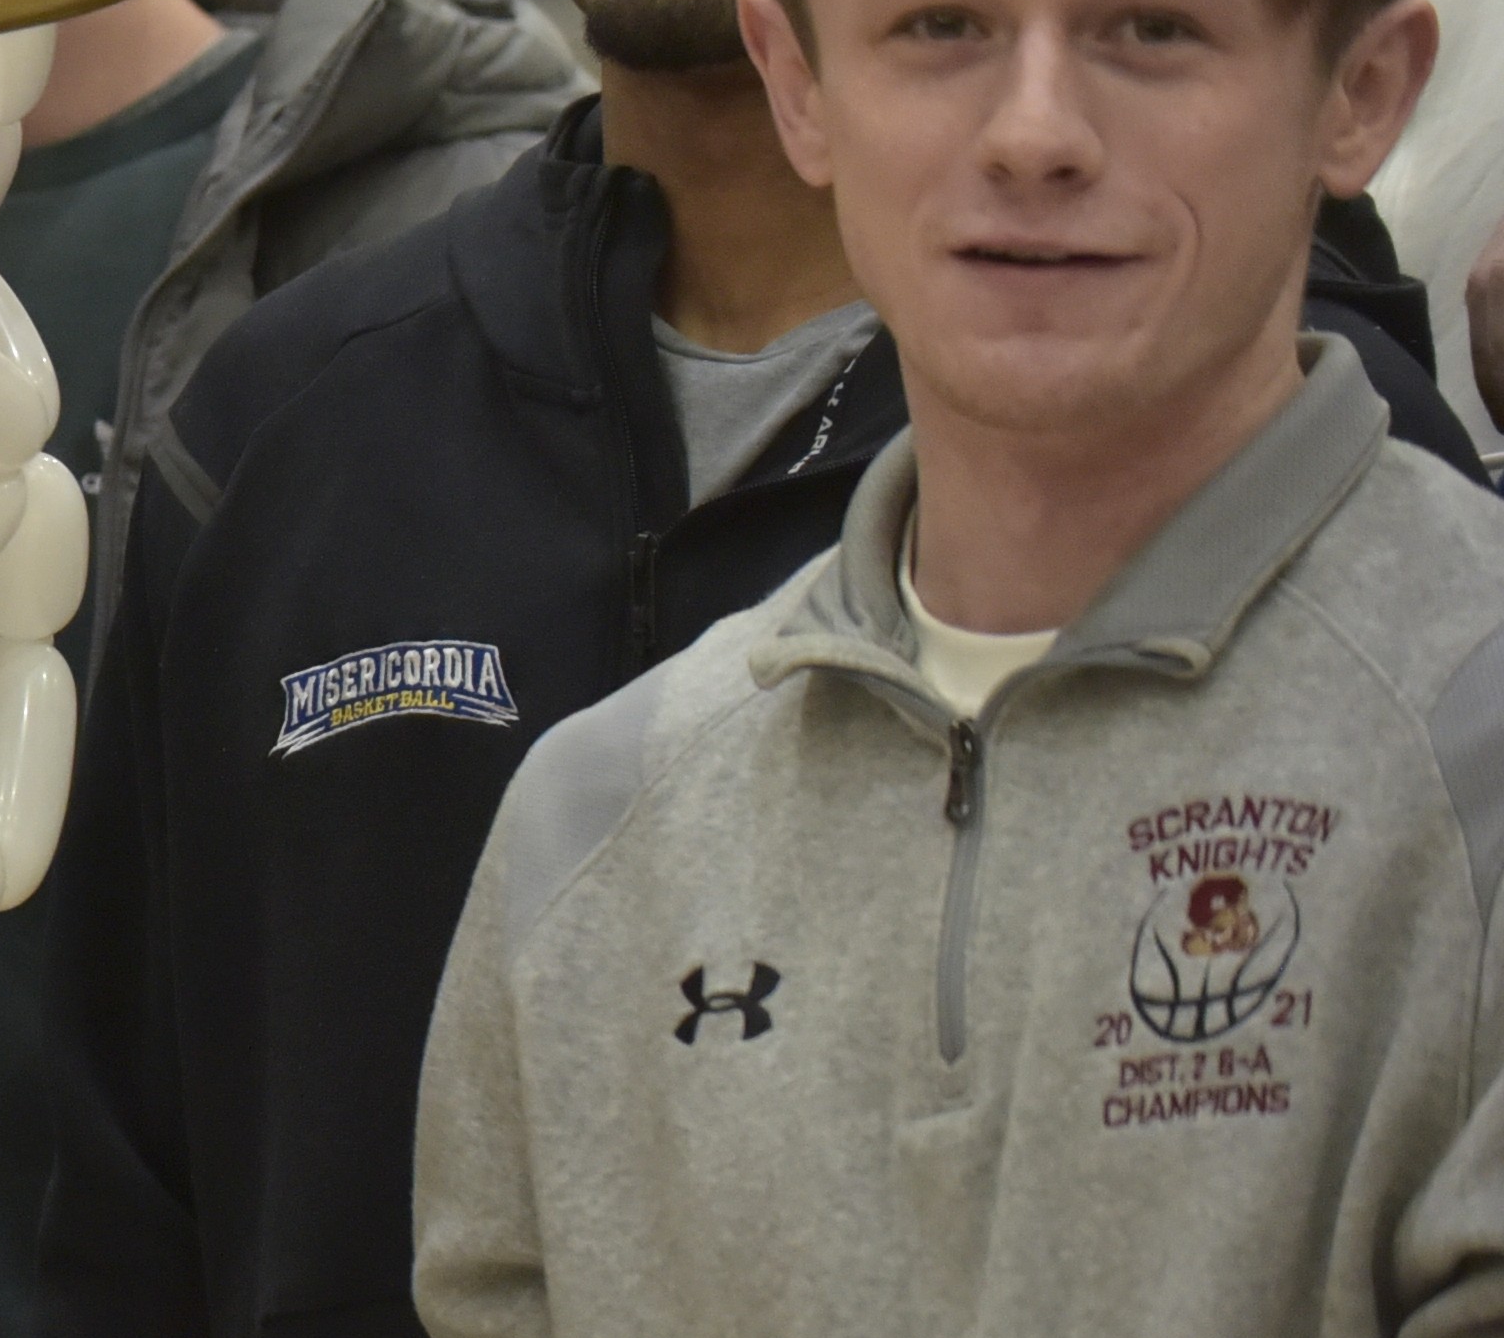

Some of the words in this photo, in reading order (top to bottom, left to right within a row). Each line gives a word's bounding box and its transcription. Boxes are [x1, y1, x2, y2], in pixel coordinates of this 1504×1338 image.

[289, 647, 504, 727] MISERICORDIA
[329, 689, 455, 728] BASKETBALL
[1126, 793, 1342, 853] SCRANTON
[1149, 836, 1315, 886] KNIGHTS
[1093, 1011, 1133, 1048] 20
[1270, 988, 1313, 1029] 21
[1102, 1081, 1291, 1129] CHAMPIONS
